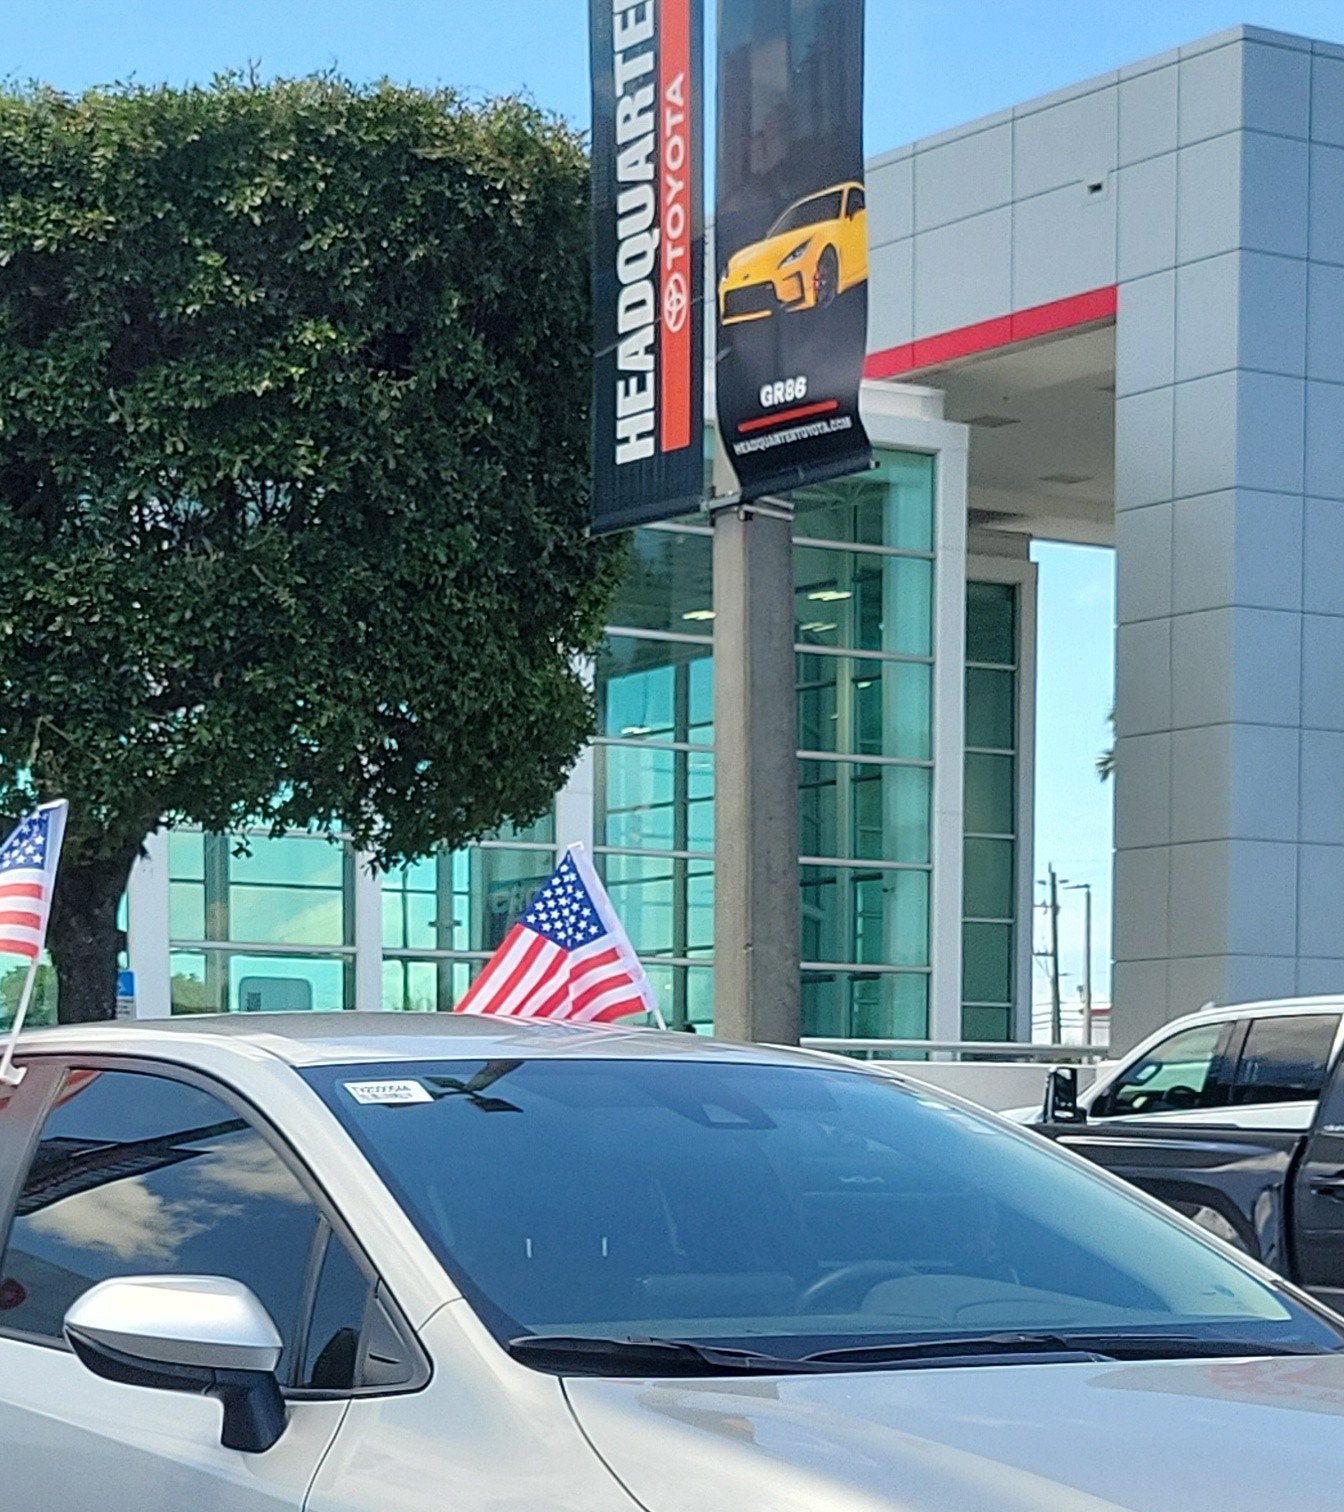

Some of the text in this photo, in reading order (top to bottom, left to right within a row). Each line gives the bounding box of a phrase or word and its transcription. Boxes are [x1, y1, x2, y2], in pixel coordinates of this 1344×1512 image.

[612, 0, 660, 465] HEADQUARTE
[664, 73, 686, 271] TOYOTA
[760, 376, 807, 407] GR86
